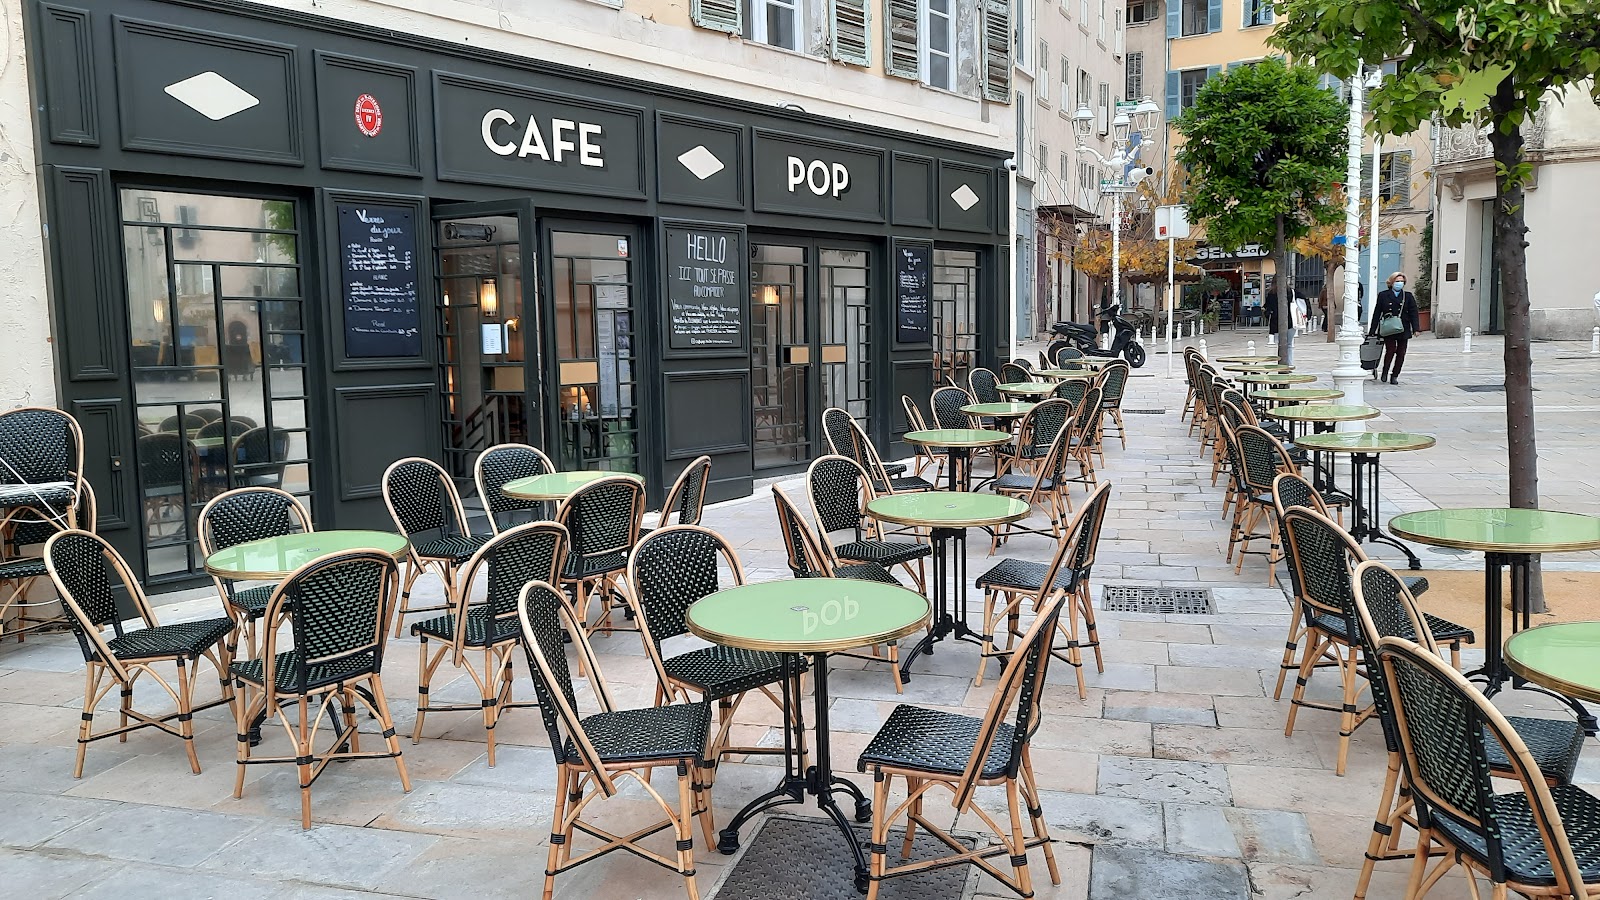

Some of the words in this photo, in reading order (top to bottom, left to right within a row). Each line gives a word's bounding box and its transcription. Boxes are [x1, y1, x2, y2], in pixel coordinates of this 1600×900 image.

[481, 108, 604, 168] CAFE
[787, 156, 849, 197] POP
[355, 209, 385, 224] Verres
[370, 225, 382, 234] du
[382, 227, 403, 239] jour
[687, 233, 727, 264] HELLO
[678, 266, 692, 281] ICI
[694, 267, 709, 284] TOUT
[710, 268, 718, 284] SE
[717, 268, 736, 285] PASSE
